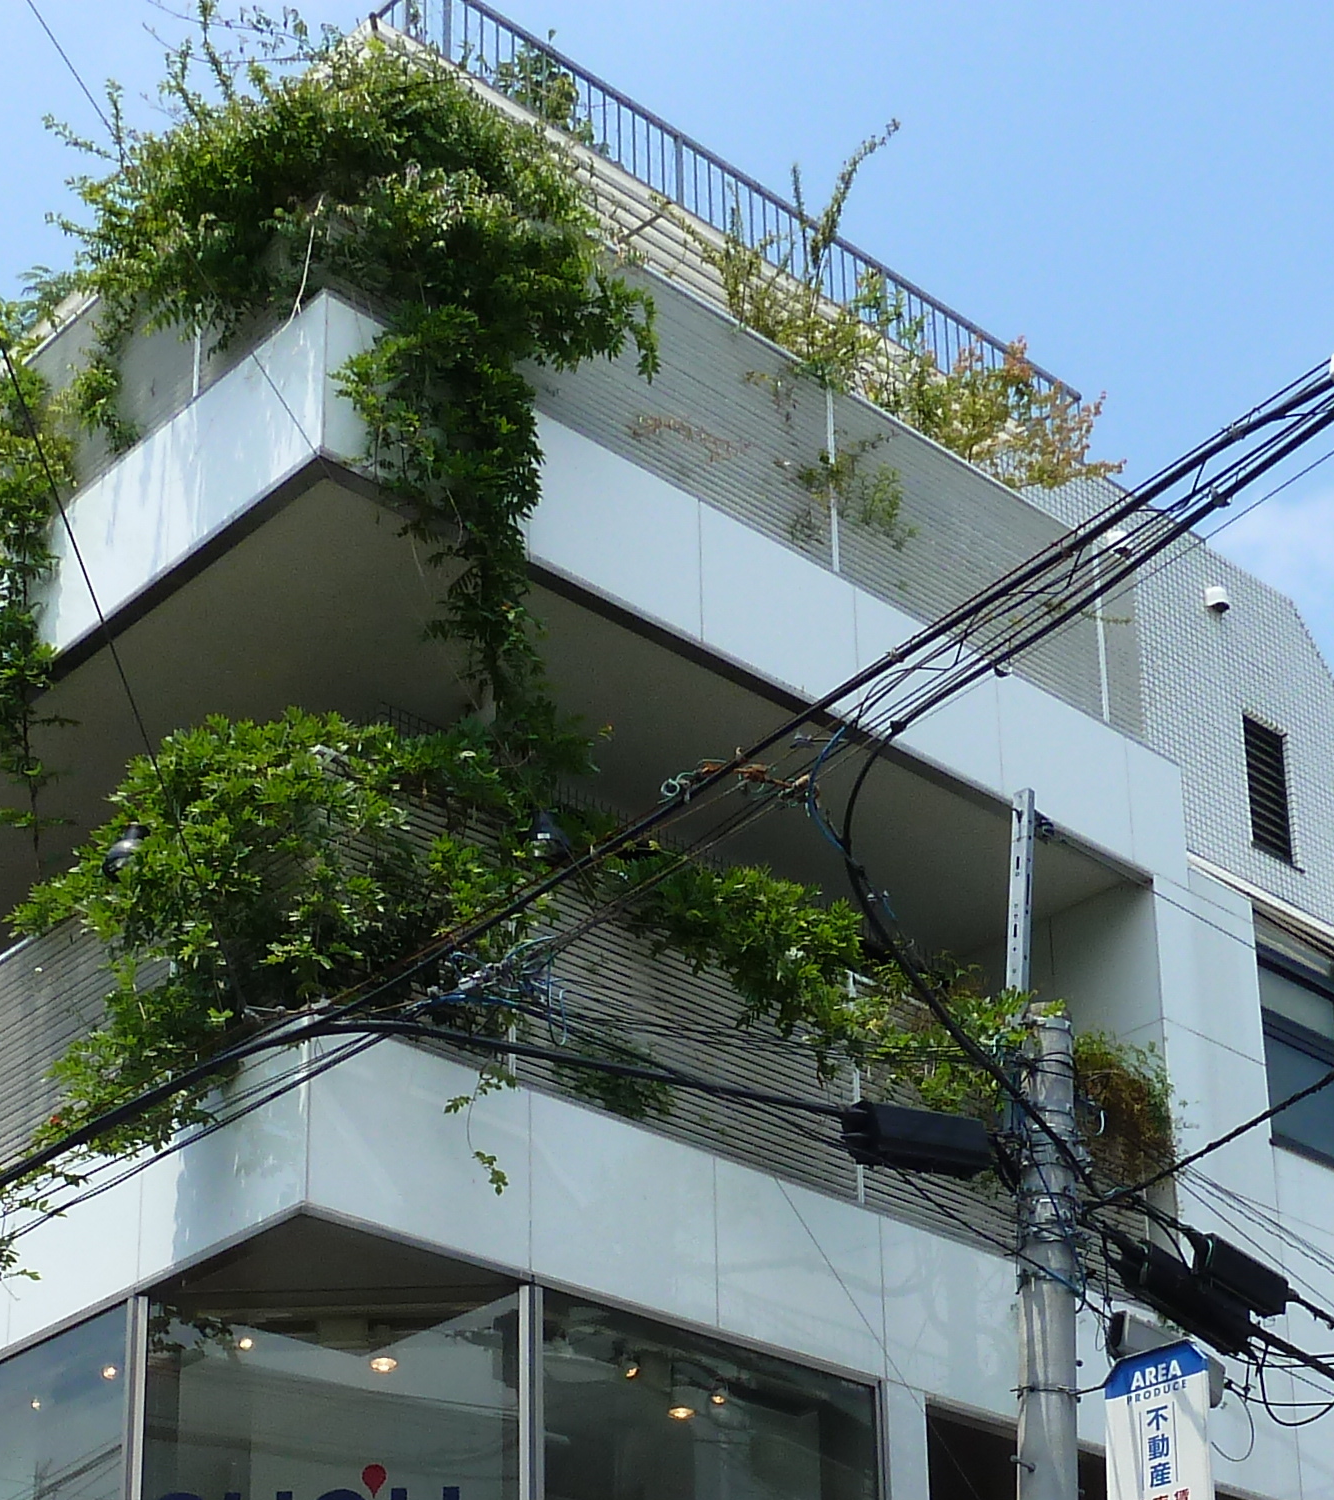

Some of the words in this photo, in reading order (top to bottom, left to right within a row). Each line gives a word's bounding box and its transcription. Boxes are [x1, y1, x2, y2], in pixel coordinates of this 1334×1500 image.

[1130, 1359, 1183, 1391] AREA
[1127, 1379, 1188, 1406] PRODUCE
[1146, 1405, 1172, 1488] 不動産
